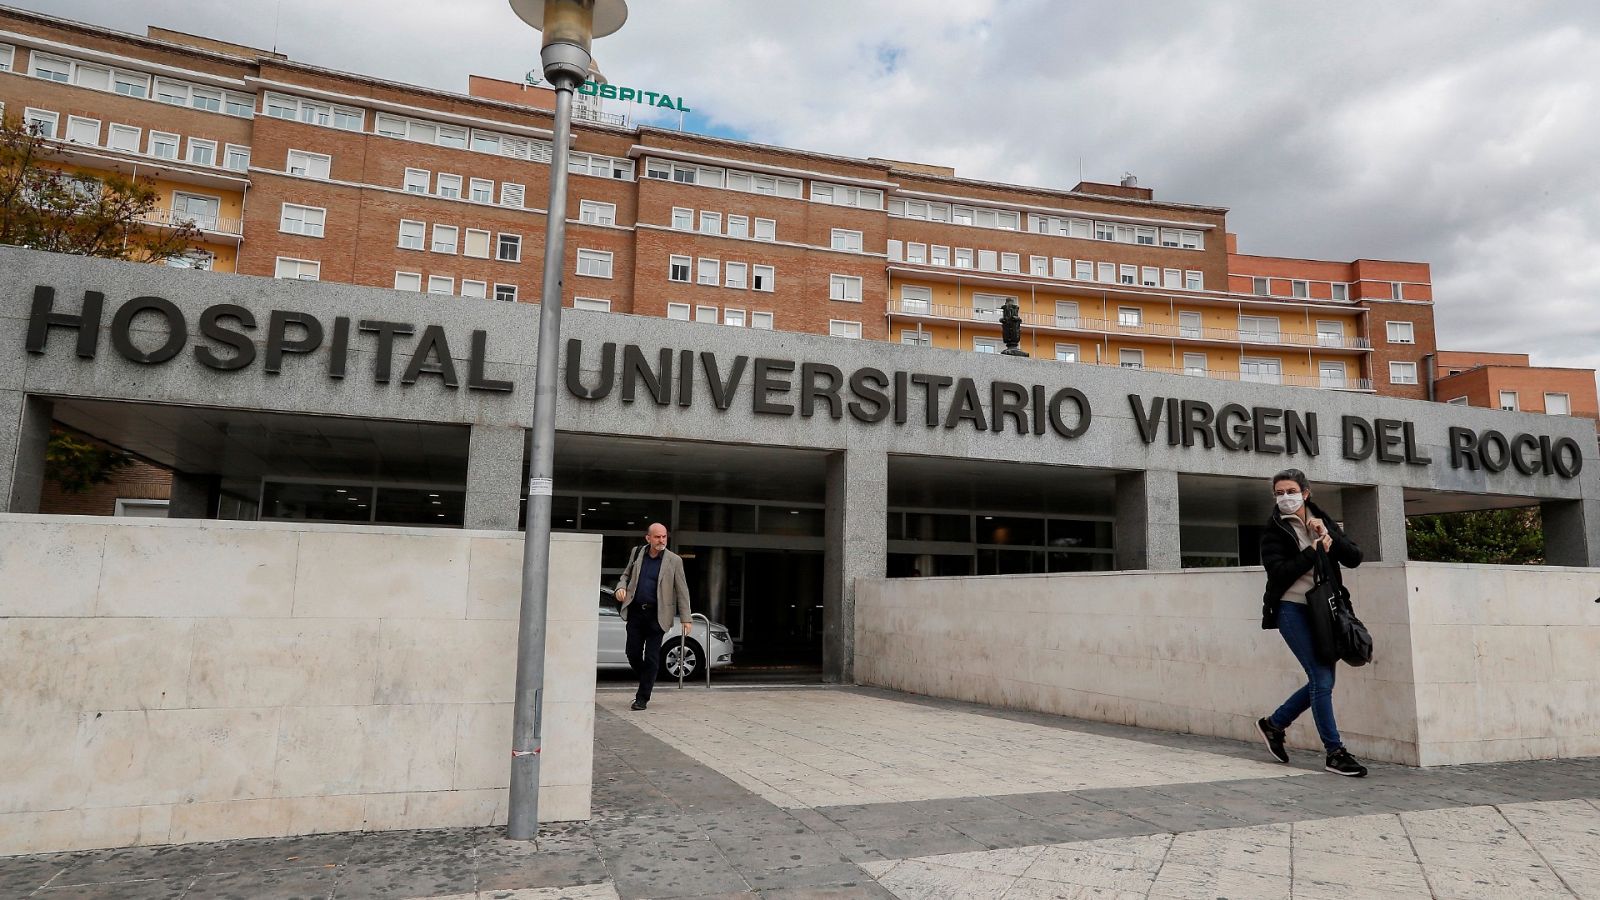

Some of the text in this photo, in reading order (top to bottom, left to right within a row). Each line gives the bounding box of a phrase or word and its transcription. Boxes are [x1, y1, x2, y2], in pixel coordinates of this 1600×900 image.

[576, 80, 691, 113] OSPITAL
[25, 285, 1583, 478] HOSPITAL UNIVERSITARIO VIRGEN DEL ROCIO
